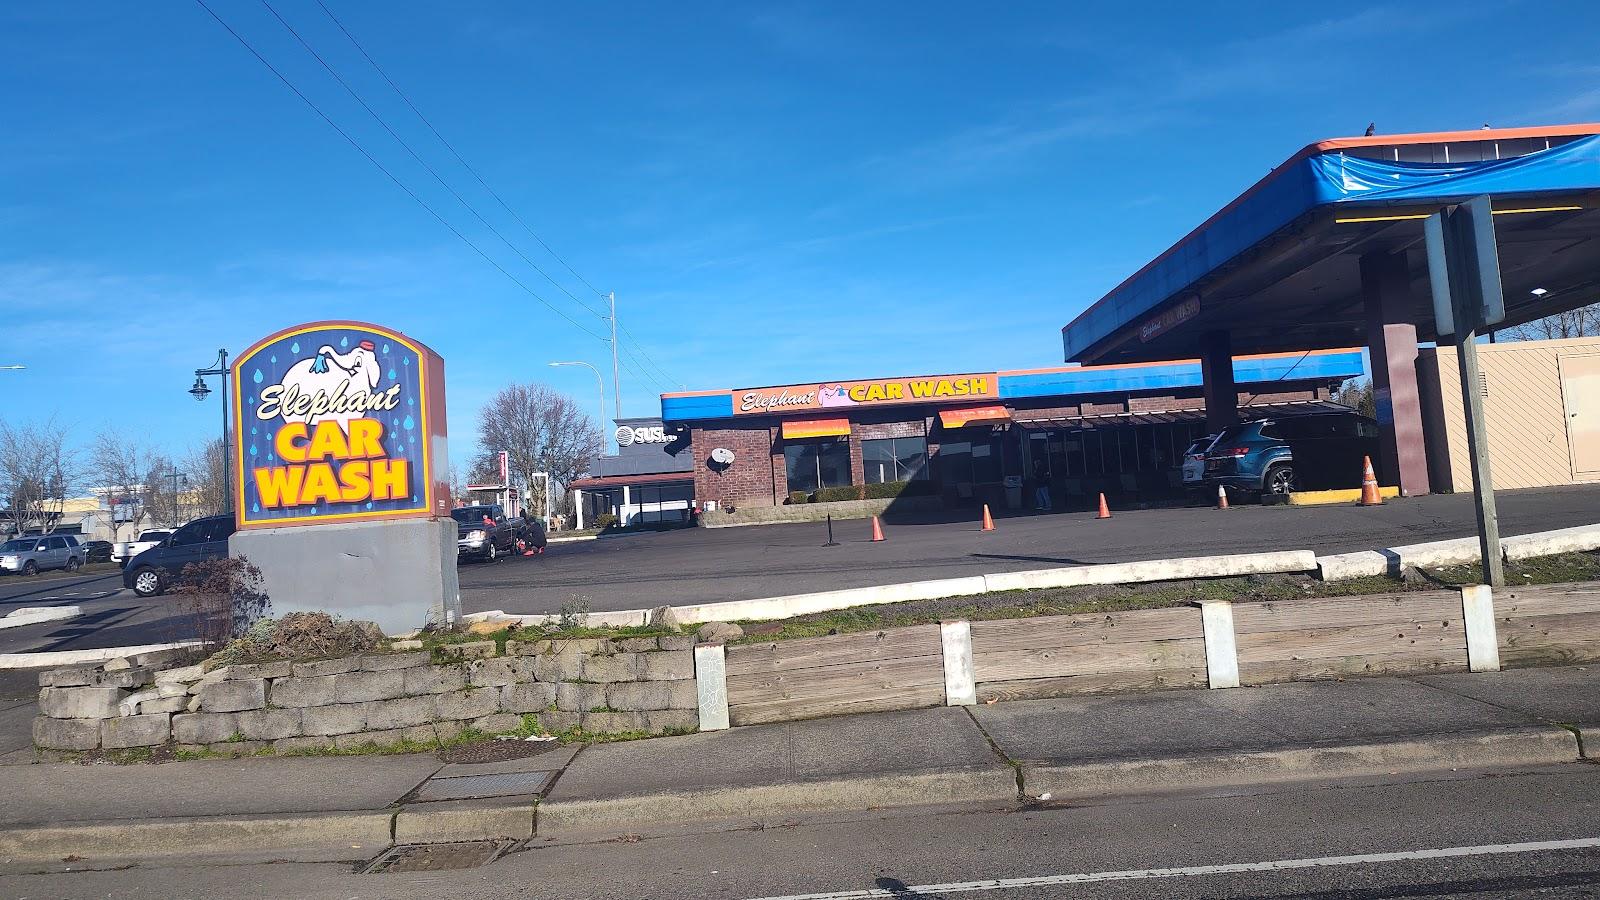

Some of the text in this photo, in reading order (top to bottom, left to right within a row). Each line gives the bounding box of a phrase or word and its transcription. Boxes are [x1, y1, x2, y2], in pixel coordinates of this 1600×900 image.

[256, 379, 401, 424] Elephant
[740, 377, 988, 412] Elephant CAR WASH
[275, 418, 386, 462] CAR
[253, 459, 408, 508] WASH
